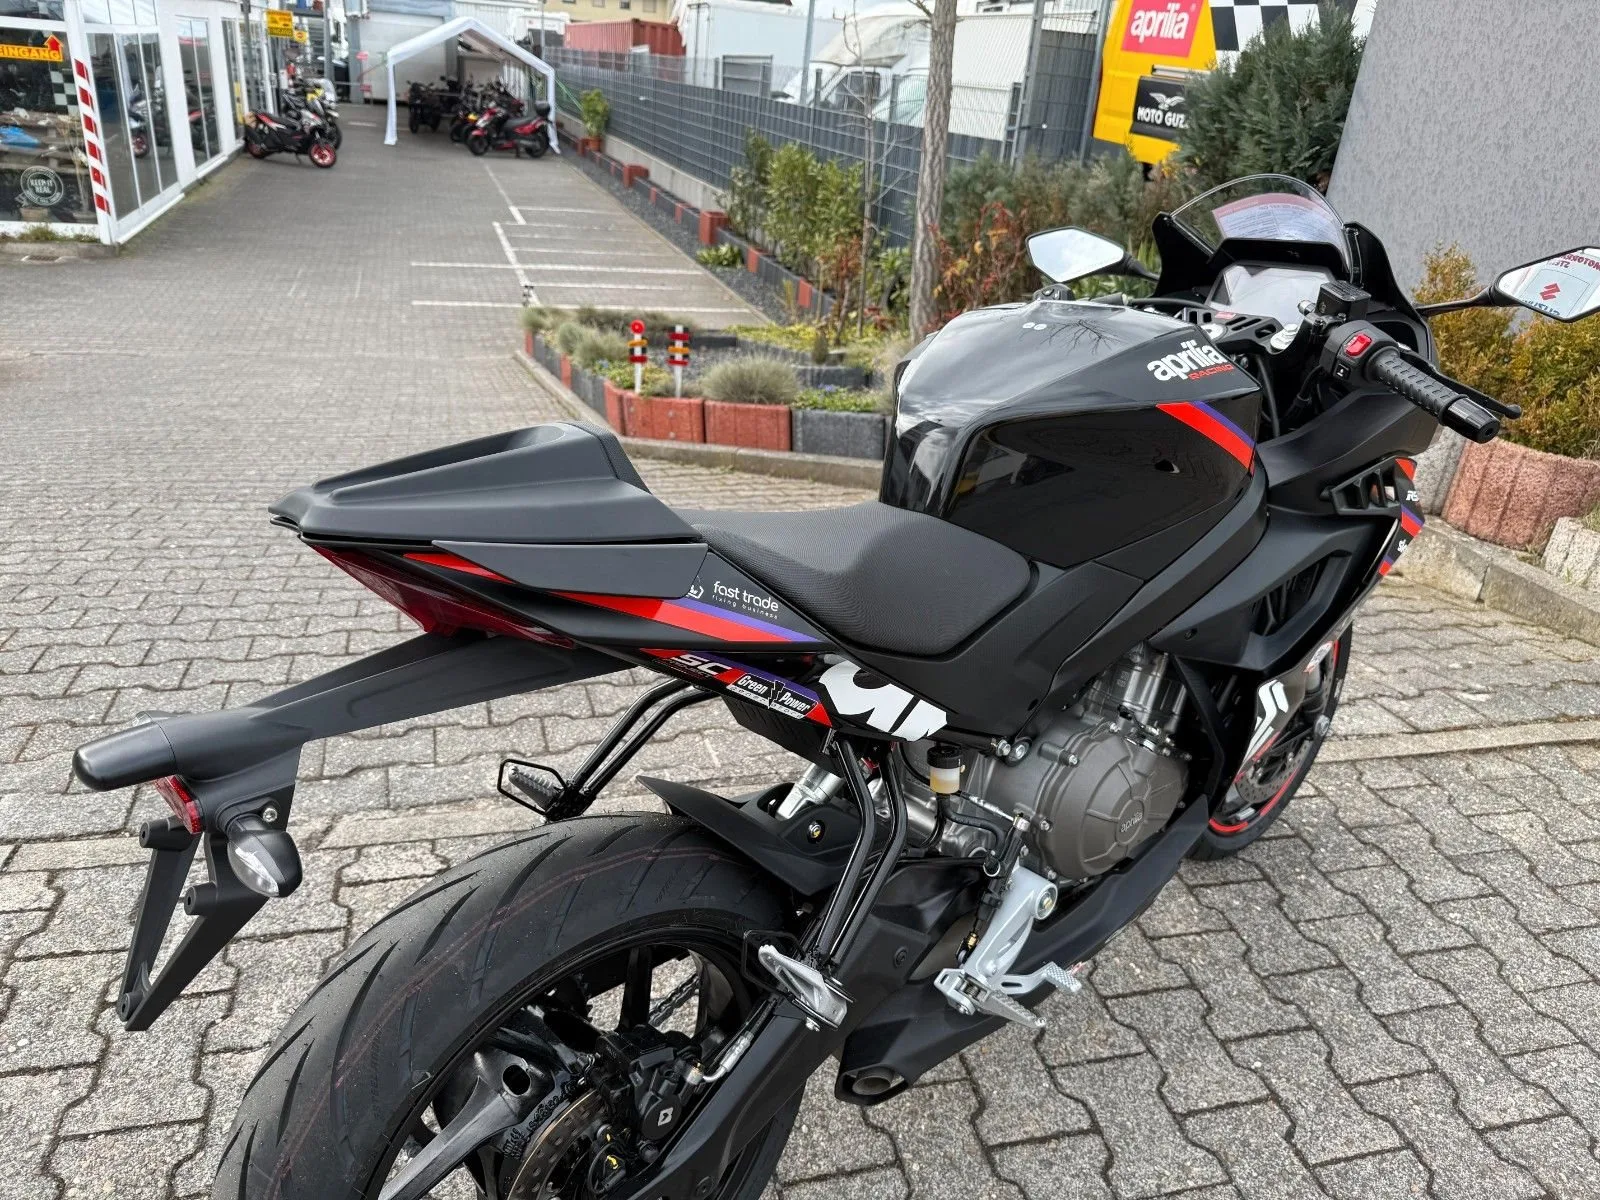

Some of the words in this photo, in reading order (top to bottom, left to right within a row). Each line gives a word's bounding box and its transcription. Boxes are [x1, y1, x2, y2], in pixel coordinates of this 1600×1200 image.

[1130, 2, 1190, 44] aprilia
[1137, 106, 1164, 125] MOTO
[1164, 111, 1190, 129] GUZ
[1146, 339, 1229, 381] aprilia
[1187, 363, 1235, 380] RACING
[713, 581, 740, 600] fast
[742, 589, 779, 612] trade
[741, 603, 778, 620] business
[737, 675, 769, 695] Green
[780, 691, 811, 712] Power
